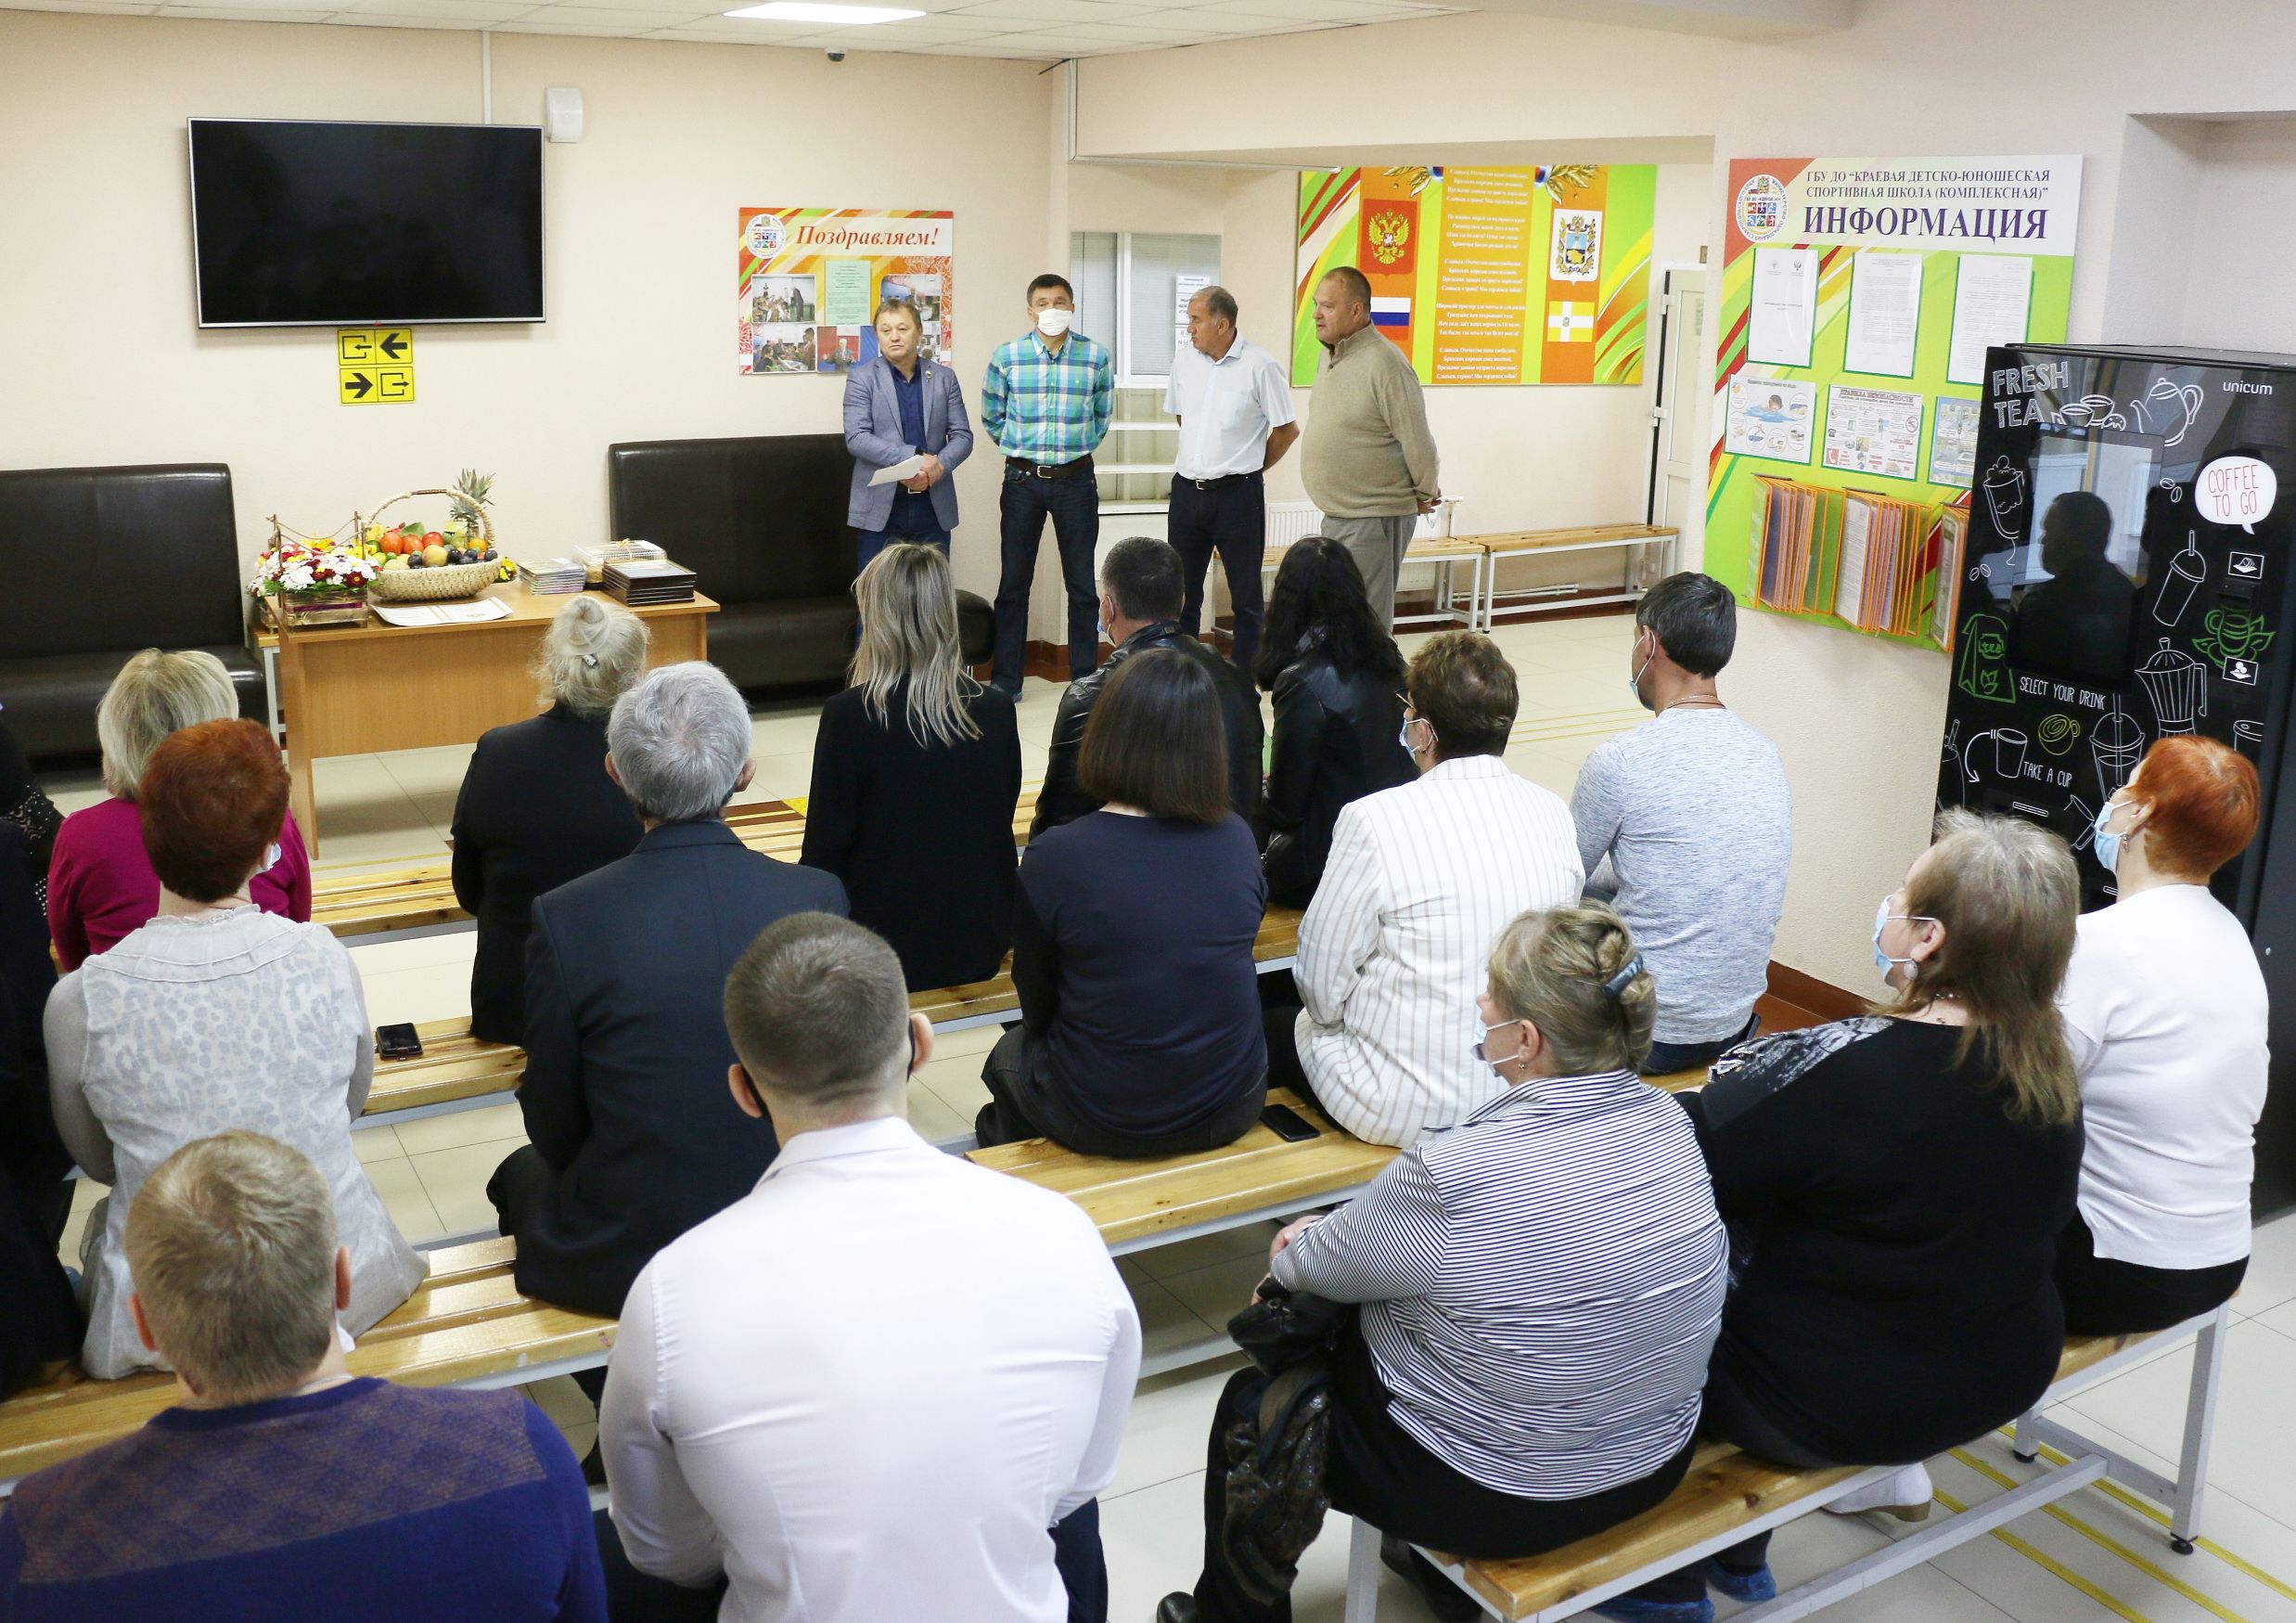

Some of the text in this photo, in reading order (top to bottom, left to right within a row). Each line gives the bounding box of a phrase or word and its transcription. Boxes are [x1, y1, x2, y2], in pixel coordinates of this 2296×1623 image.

[1806, 171, 1828, 182] ГБУ
[1829, 171, 1847, 183] ДО
[1907, 170, 2051, 184] ДЕТСКО-ЮНОШЕСКАЯ
[1805, 187, 1885, 199] СПОРТИВНАЯ
[1887, 187, 1932, 199] ШКОЛА
[796, 225, 940, 250] Поздравляем!
[1802, 205, 2048, 245] ИНФОРМАЦИЯ
[1993, 361, 2070, 396] FRESH
[2223, 381, 2273, 395] unicum
[1994, 398, 2045, 429] TEA
[2208, 464, 2259, 494] COFFEE
[2213, 490, 2257, 517] TO GO
[2020, 676, 2106, 710] SELECT YOUR DRINK
[2023, 761, 2072, 788] TAKE A CUP
